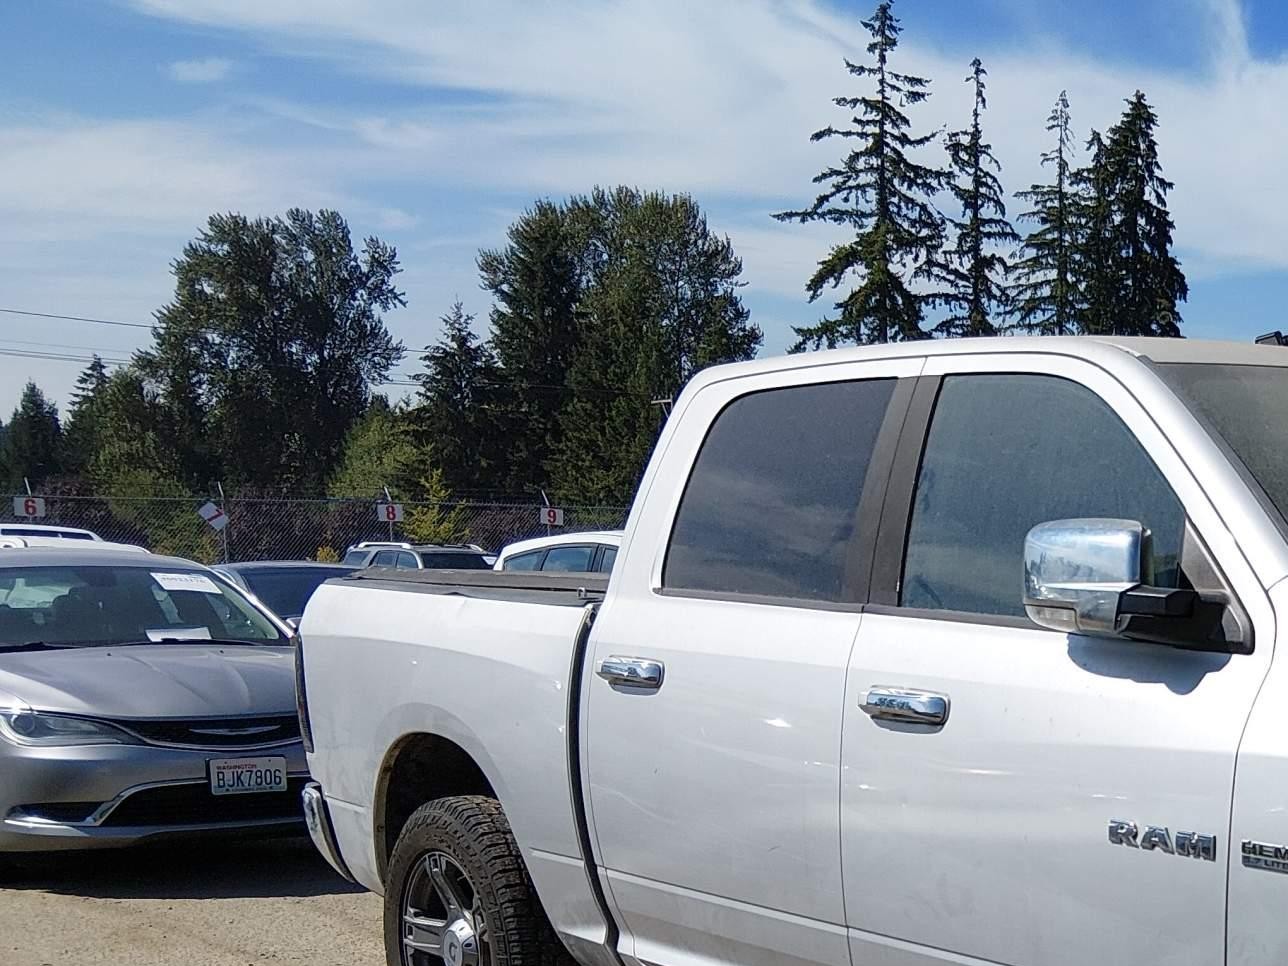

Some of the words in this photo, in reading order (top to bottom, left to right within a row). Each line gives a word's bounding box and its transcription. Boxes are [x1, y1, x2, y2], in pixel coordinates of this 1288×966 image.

[24, 499, 37, 516] 6
[386, 505, 397, 521] 8
[547, 509, 557, 524] 9
[216, 769, 282, 788] BJK7806
[1108, 818, 1217, 862] RAM
